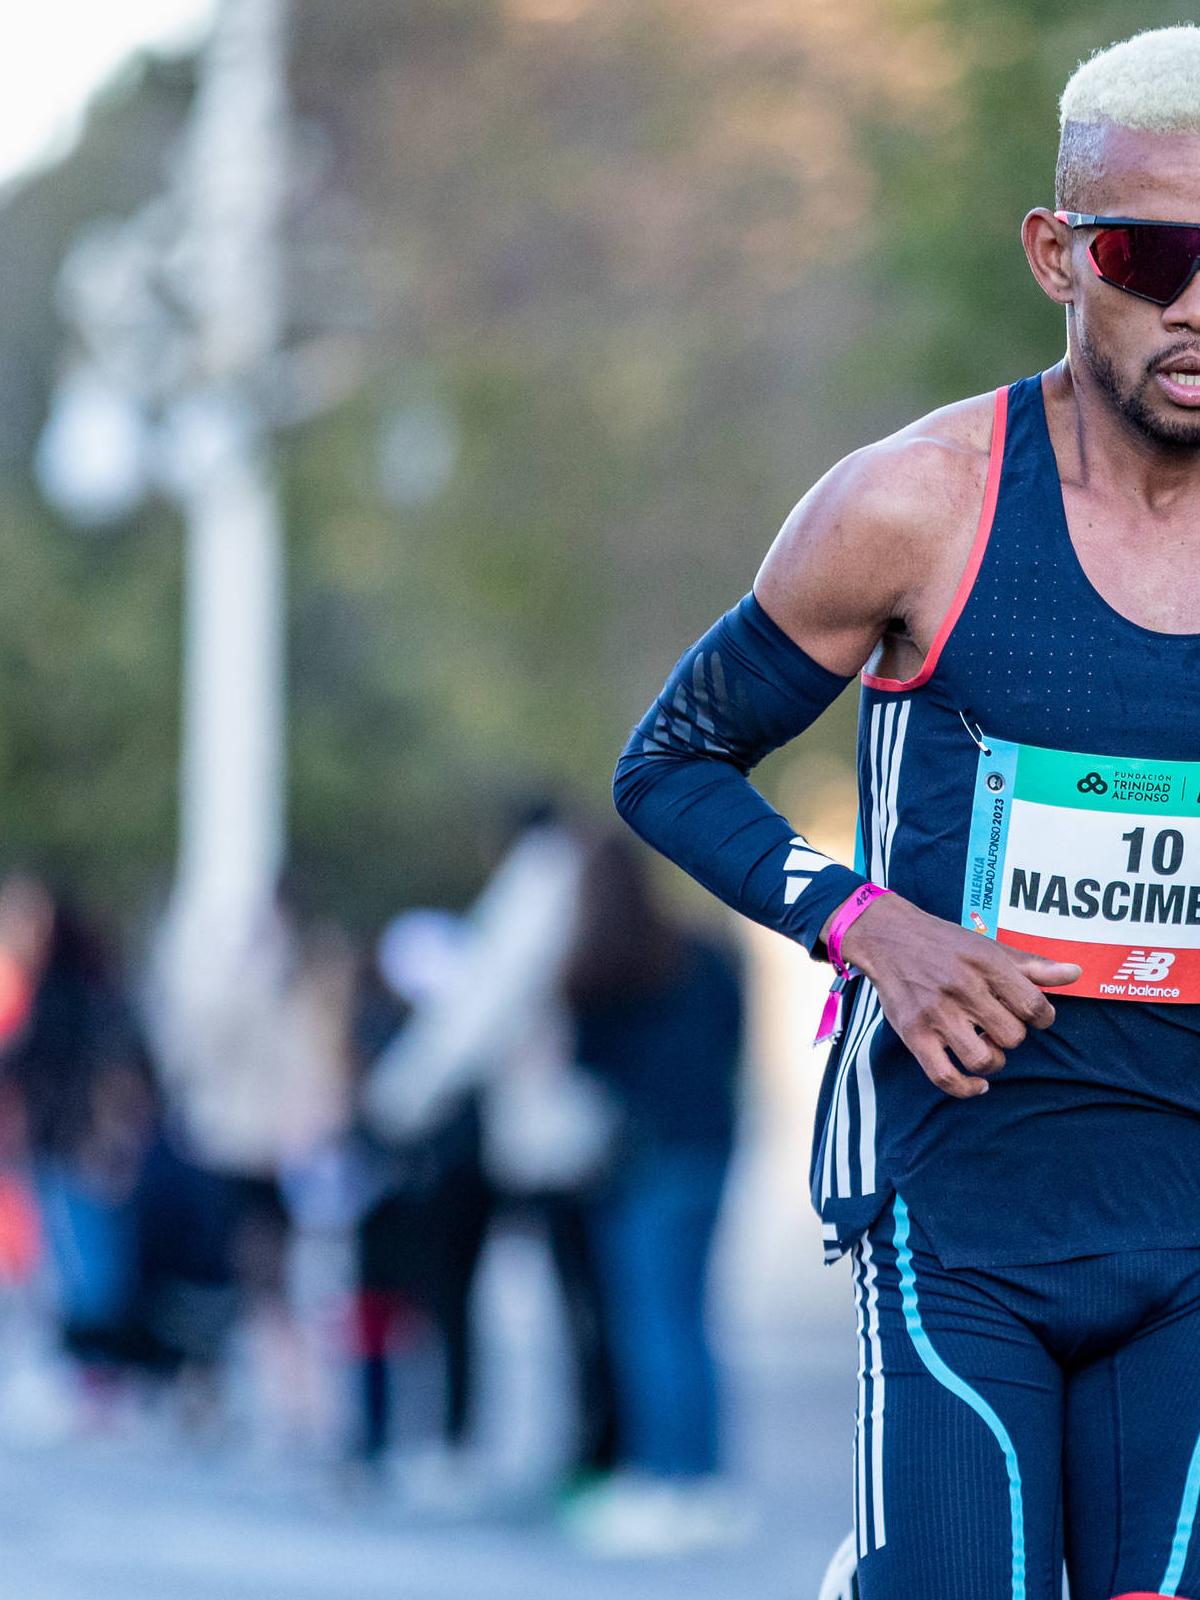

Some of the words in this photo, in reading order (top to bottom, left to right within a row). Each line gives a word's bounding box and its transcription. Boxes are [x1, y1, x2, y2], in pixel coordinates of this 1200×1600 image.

[1113, 780, 1171, 792] TRINIDAD
[1114, 771, 1172, 781] FUNDACIÓN
[1112, 791, 1169, 803] ALFONSO
[992, 798, 1005, 826] 2023
[987, 826, 1001, 870] ALFONSO
[1122, 827, 1185, 876] 10
[970, 857, 985, 907] VALENCIA
[982, 870, 995, 910] TRINIDAD
[1099, 983, 1126, 994] new
[1127, 983, 1180, 998] balance
